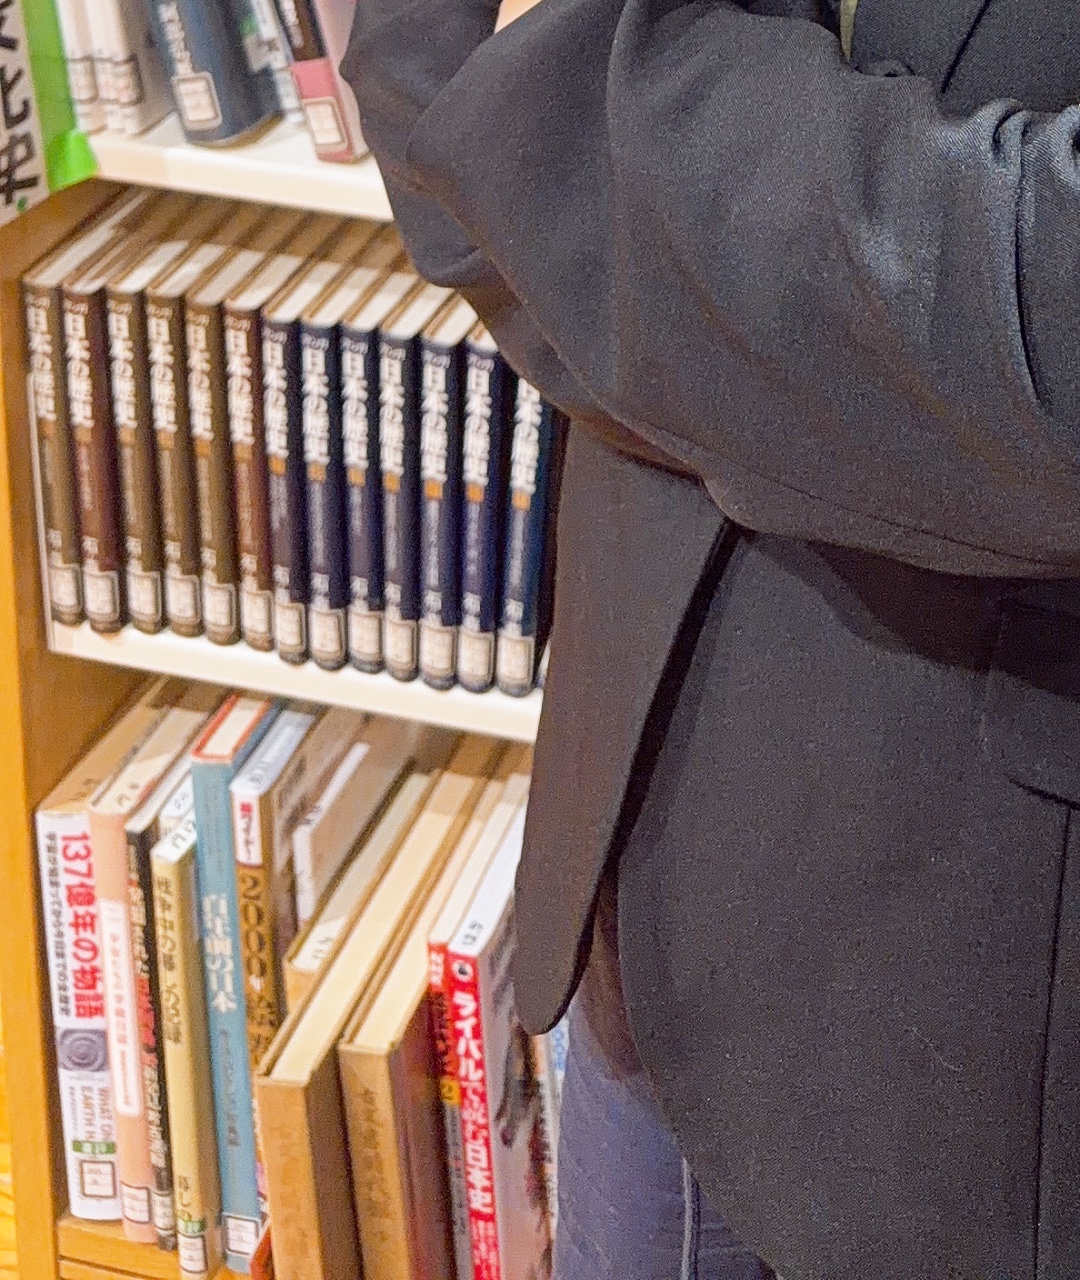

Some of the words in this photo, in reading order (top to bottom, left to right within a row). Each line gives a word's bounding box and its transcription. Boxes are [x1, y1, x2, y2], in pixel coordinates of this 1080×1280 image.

[60, 832, 105, 1019] 137億年の物語
